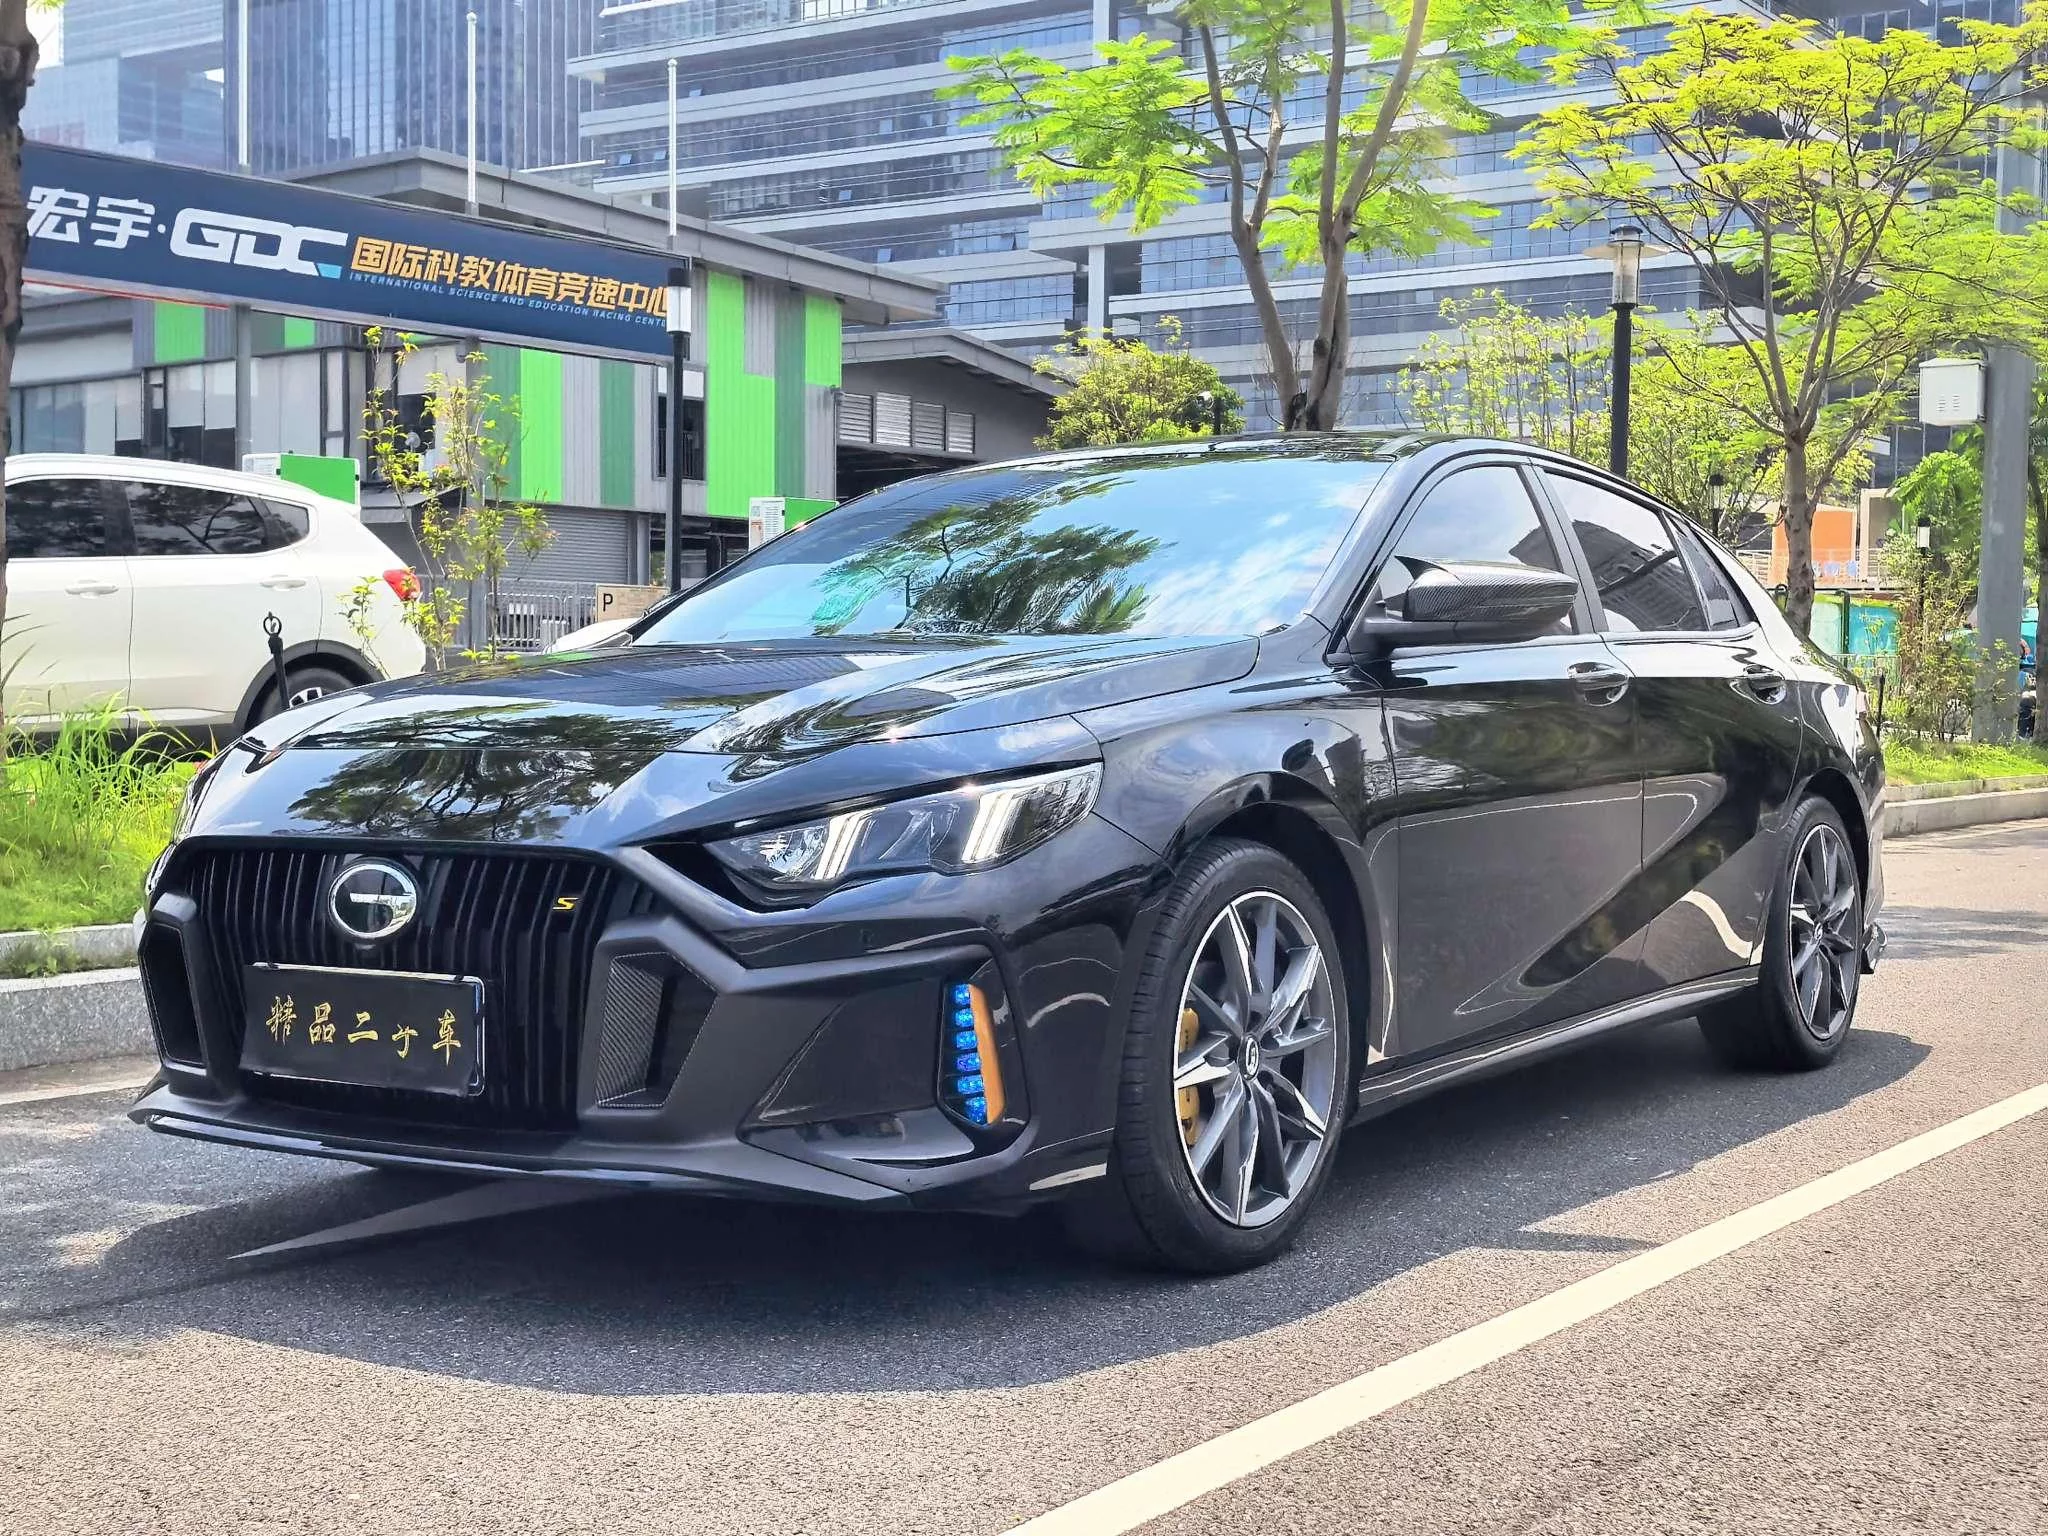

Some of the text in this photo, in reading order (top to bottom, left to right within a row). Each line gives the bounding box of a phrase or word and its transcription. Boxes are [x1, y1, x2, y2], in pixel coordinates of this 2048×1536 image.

[350, 271, 444, 294] INTERNATIONAL
[449, 286, 497, 302] SCIENCE
[502, 294, 524, 306] AND
[528, 299, 589, 316] EDUCATION
[593, 310, 631, 323] RACING
[603, 593, 613, 612] P
